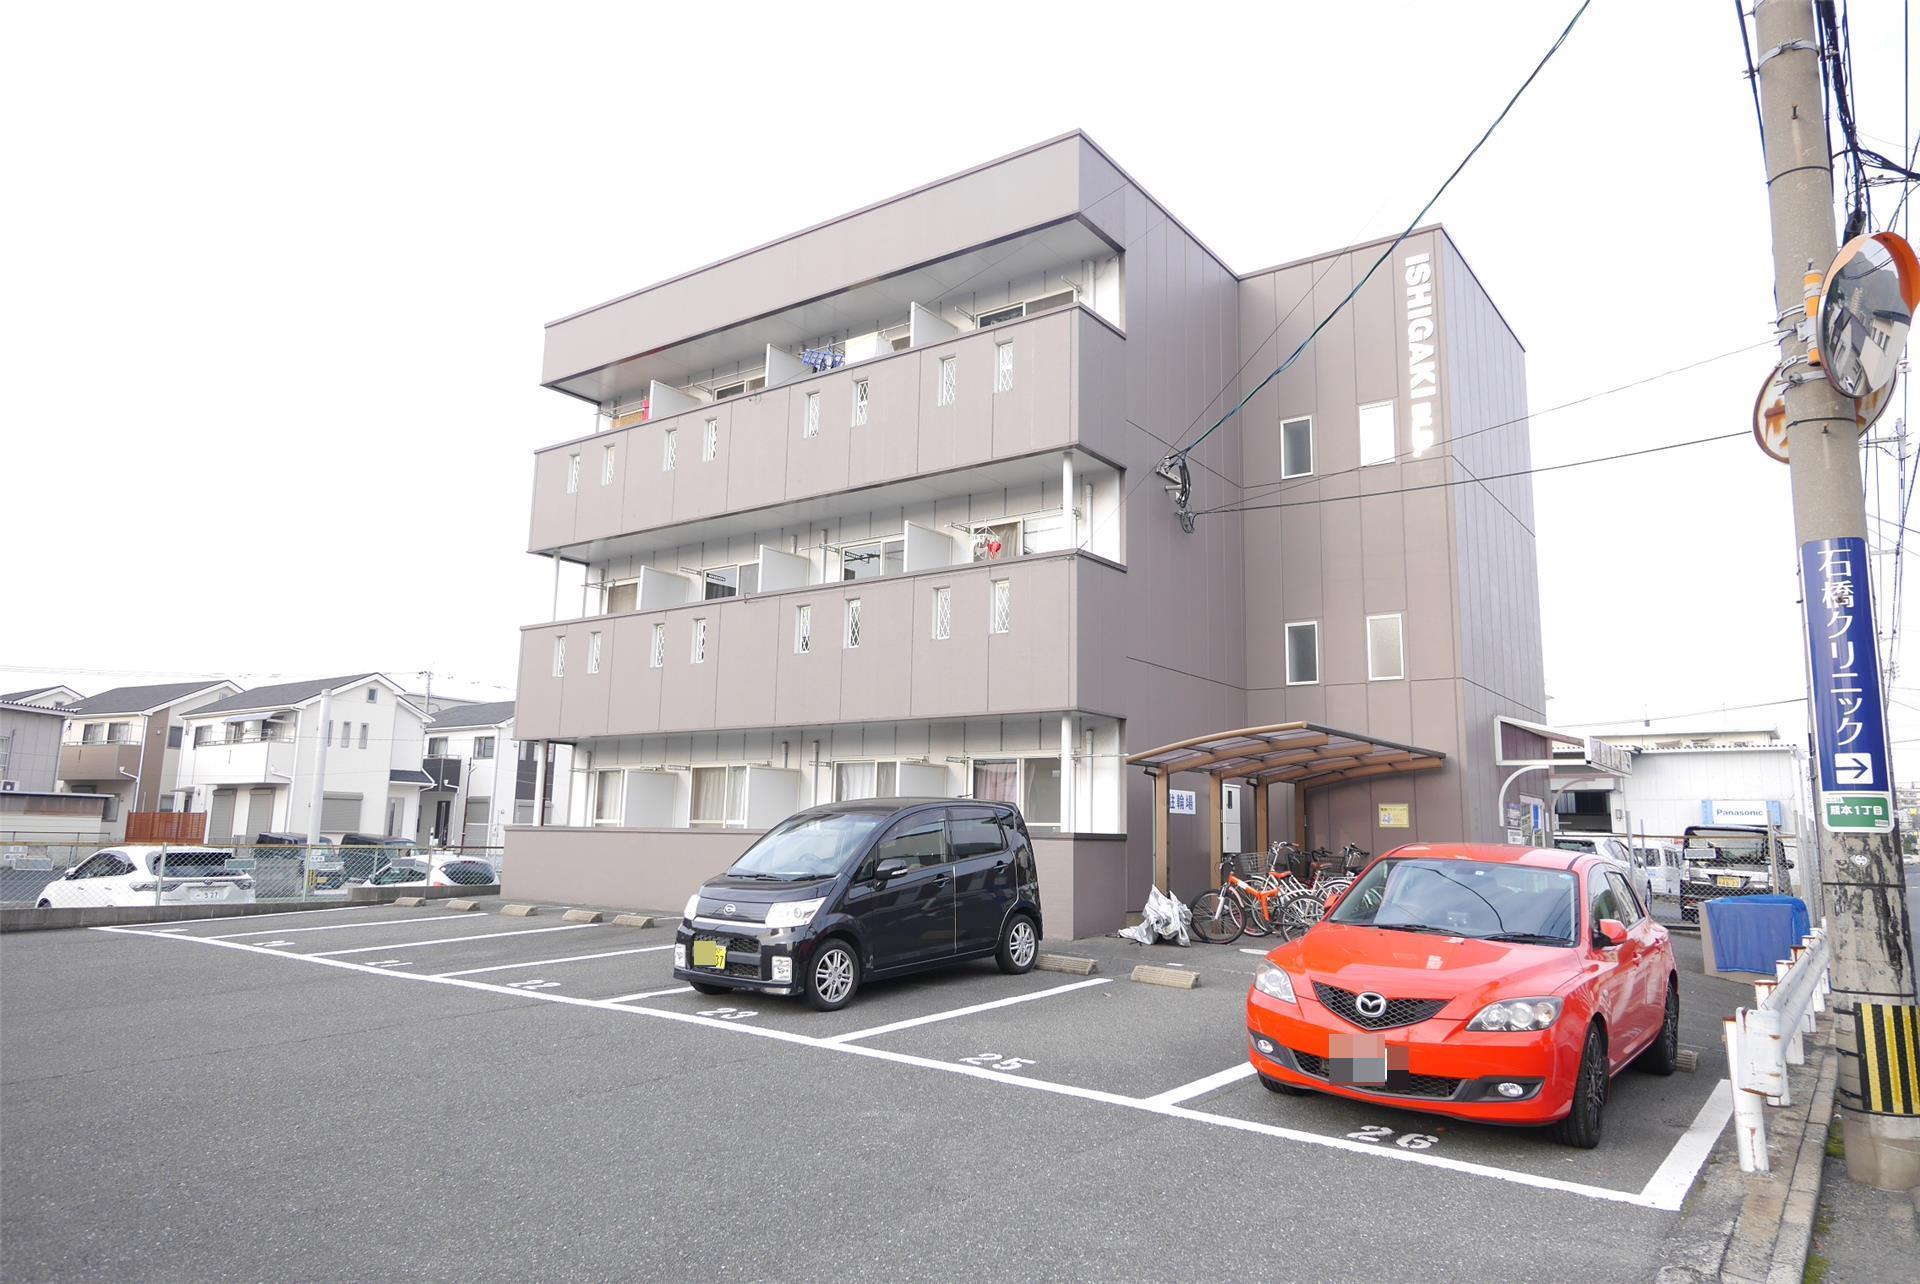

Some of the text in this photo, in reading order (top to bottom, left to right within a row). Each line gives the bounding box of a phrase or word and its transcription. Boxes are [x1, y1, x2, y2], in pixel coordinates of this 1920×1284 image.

[1405, 252, 1437, 399] ISHIGAKI
[1817, 548, 1863, 746] 石橋クリニック
[1716, 808, 1764, 816] Panasonic
[695, 1007, 759, 1020] 23
[958, 1053, 1037, 1070] 25
[1346, 1125, 1440, 1149] 26
